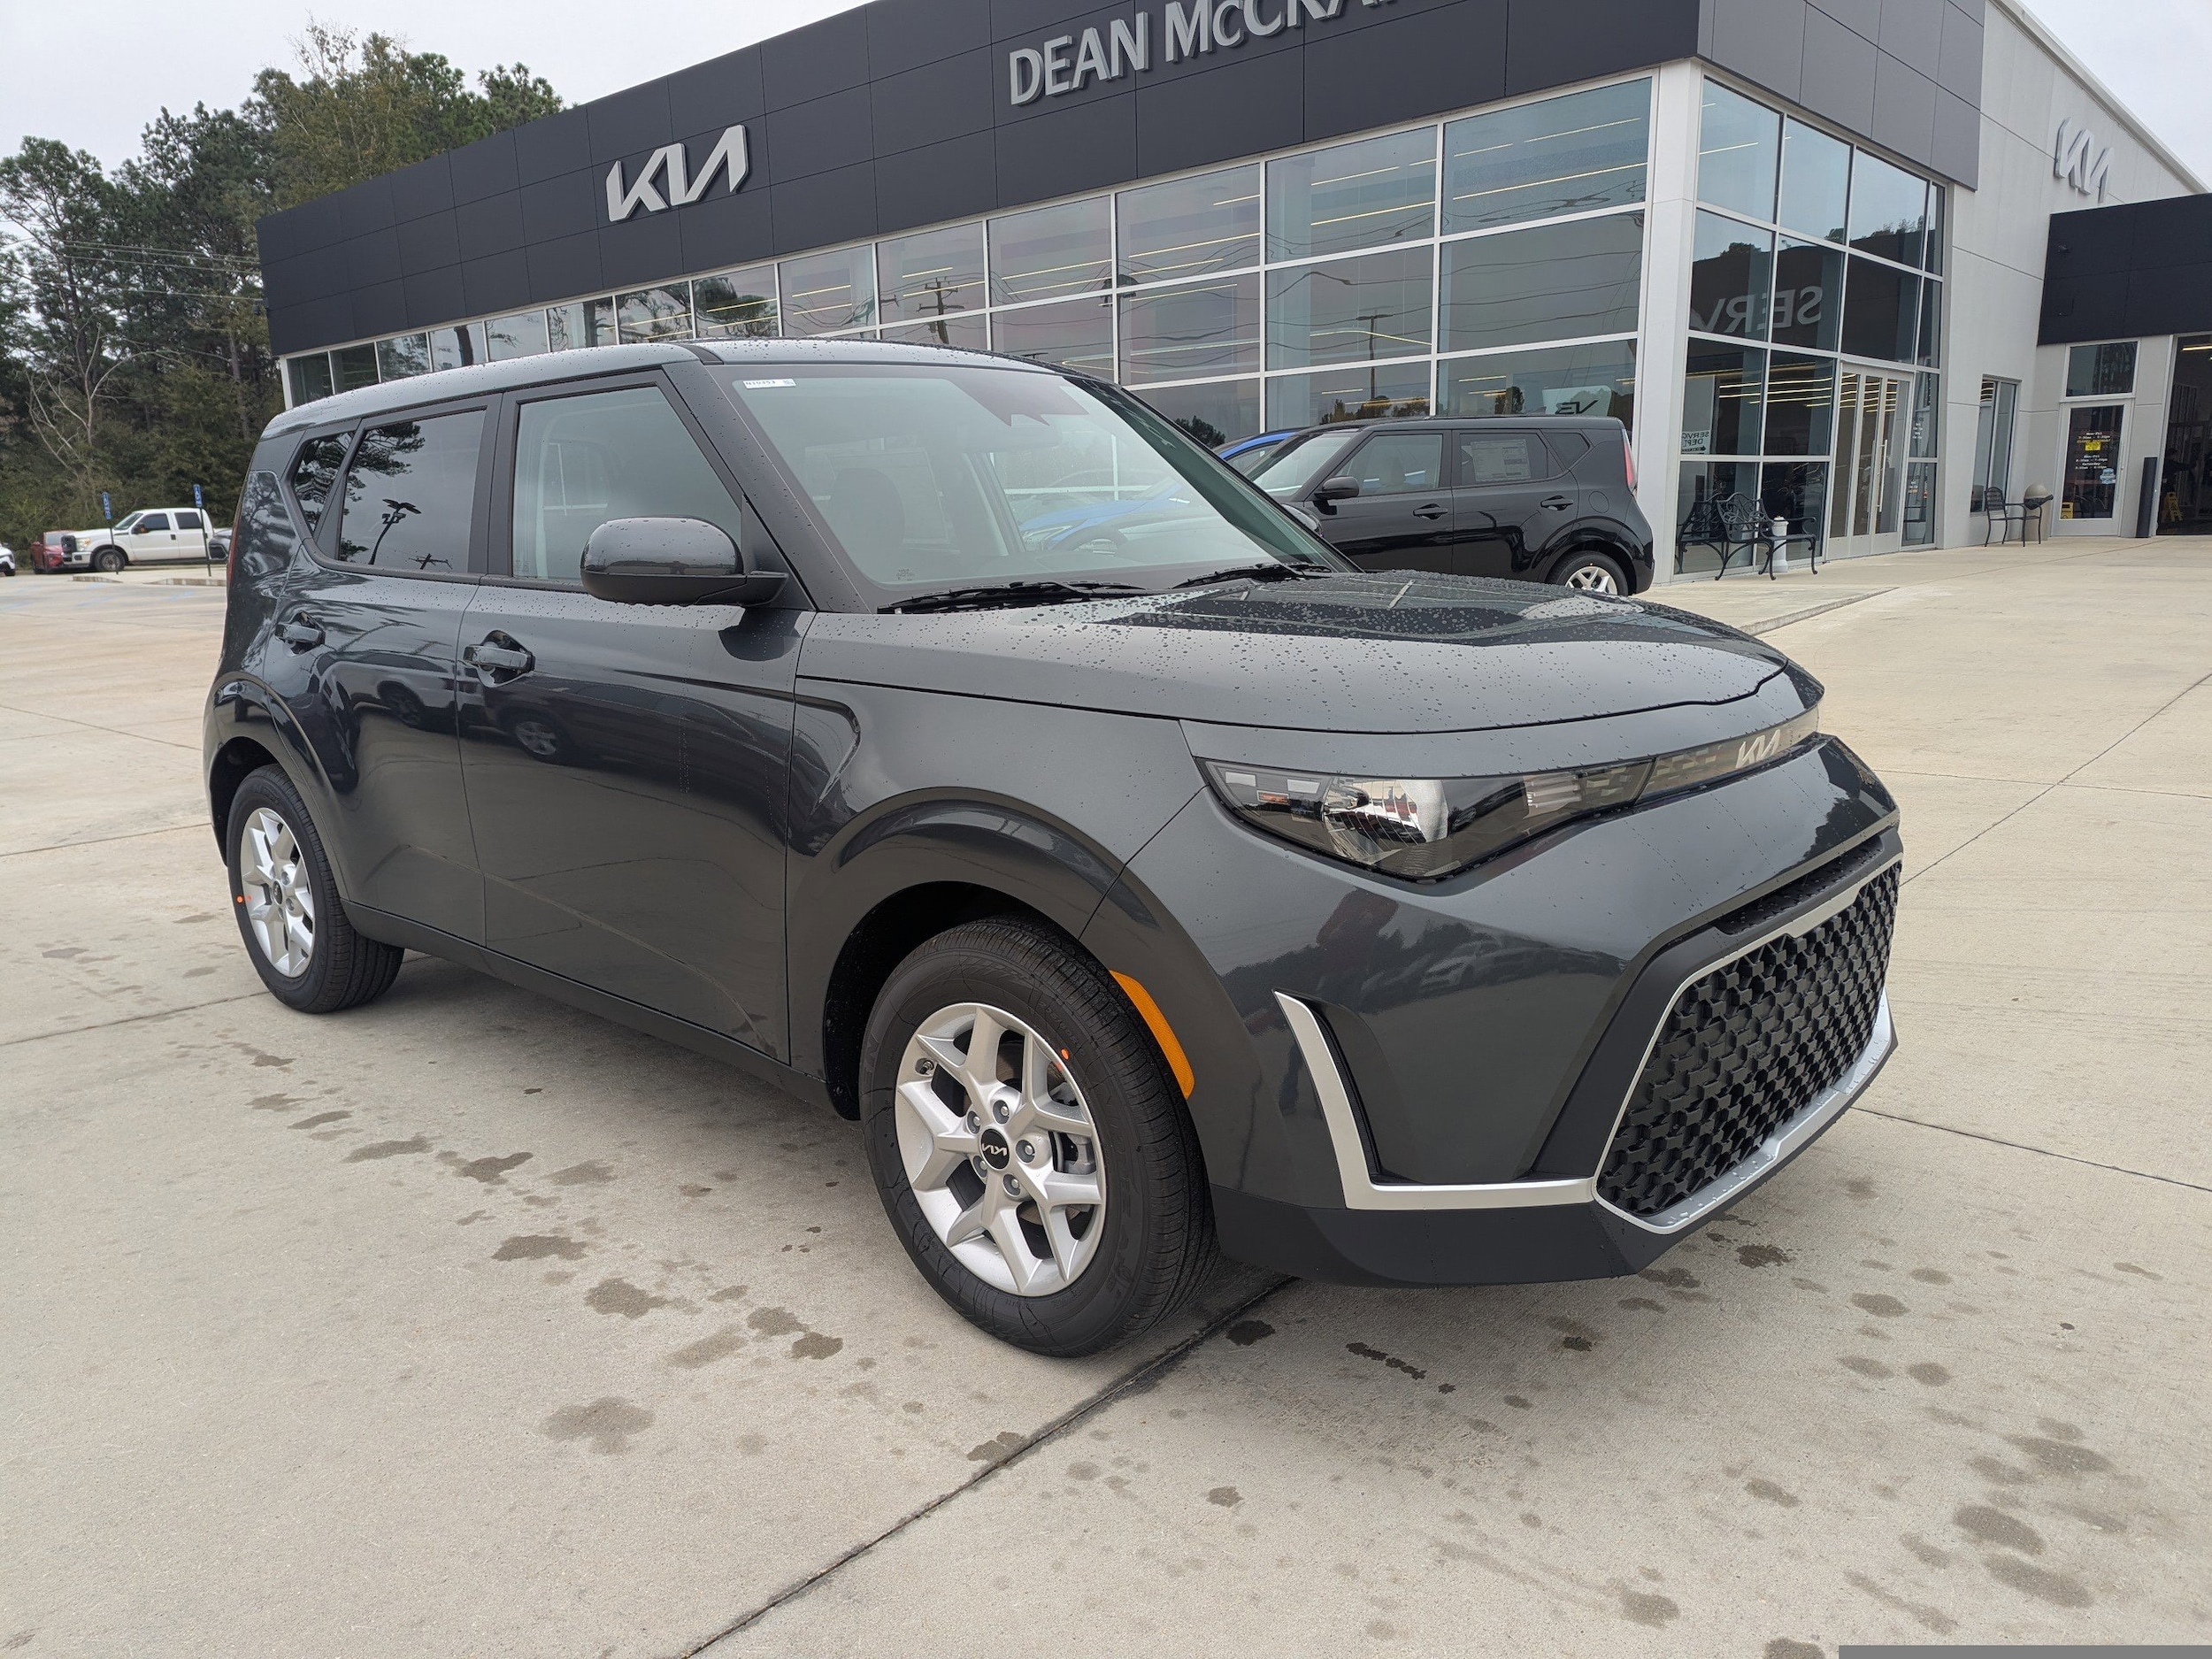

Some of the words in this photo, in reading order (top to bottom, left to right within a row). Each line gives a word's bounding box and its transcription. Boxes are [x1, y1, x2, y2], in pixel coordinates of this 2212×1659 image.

[1010, 12, 1148, 105] DEAN
[606, 125, 749, 221] KIA
[1735, 729, 1780, 769] KIA
[982, 1143, 1008, 1156] KIA
